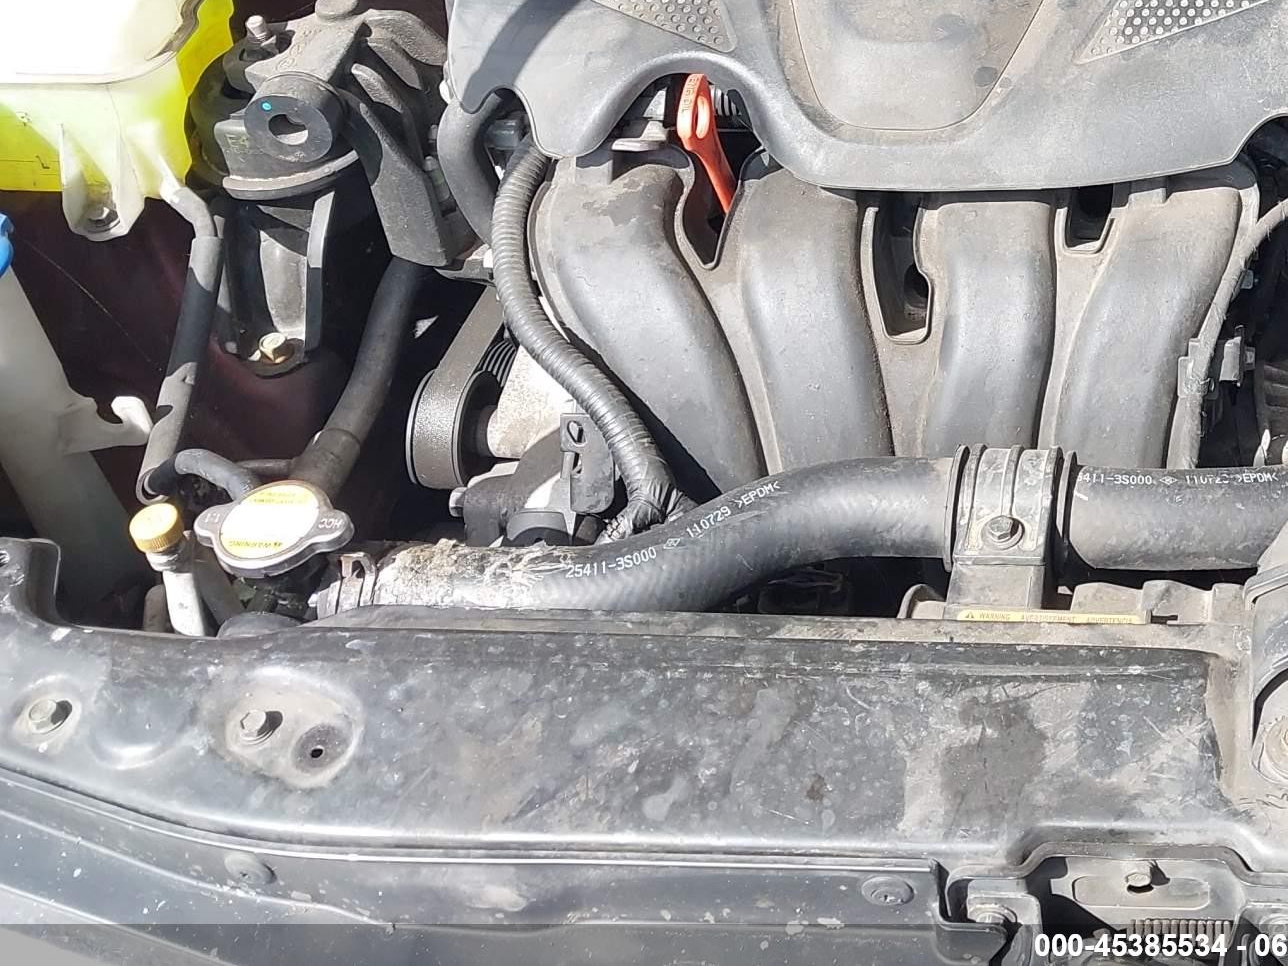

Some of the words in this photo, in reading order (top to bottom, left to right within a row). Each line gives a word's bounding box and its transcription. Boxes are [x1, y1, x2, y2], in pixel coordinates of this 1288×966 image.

[1077, 472, 1153, 486] 5411-3S000
[318, 518, 344, 529] HCC
[565, 546, 657, 579] 25411-3S000
[686, 506, 732, 538] 110729
[979, 612, 1011, 621] WARNING
